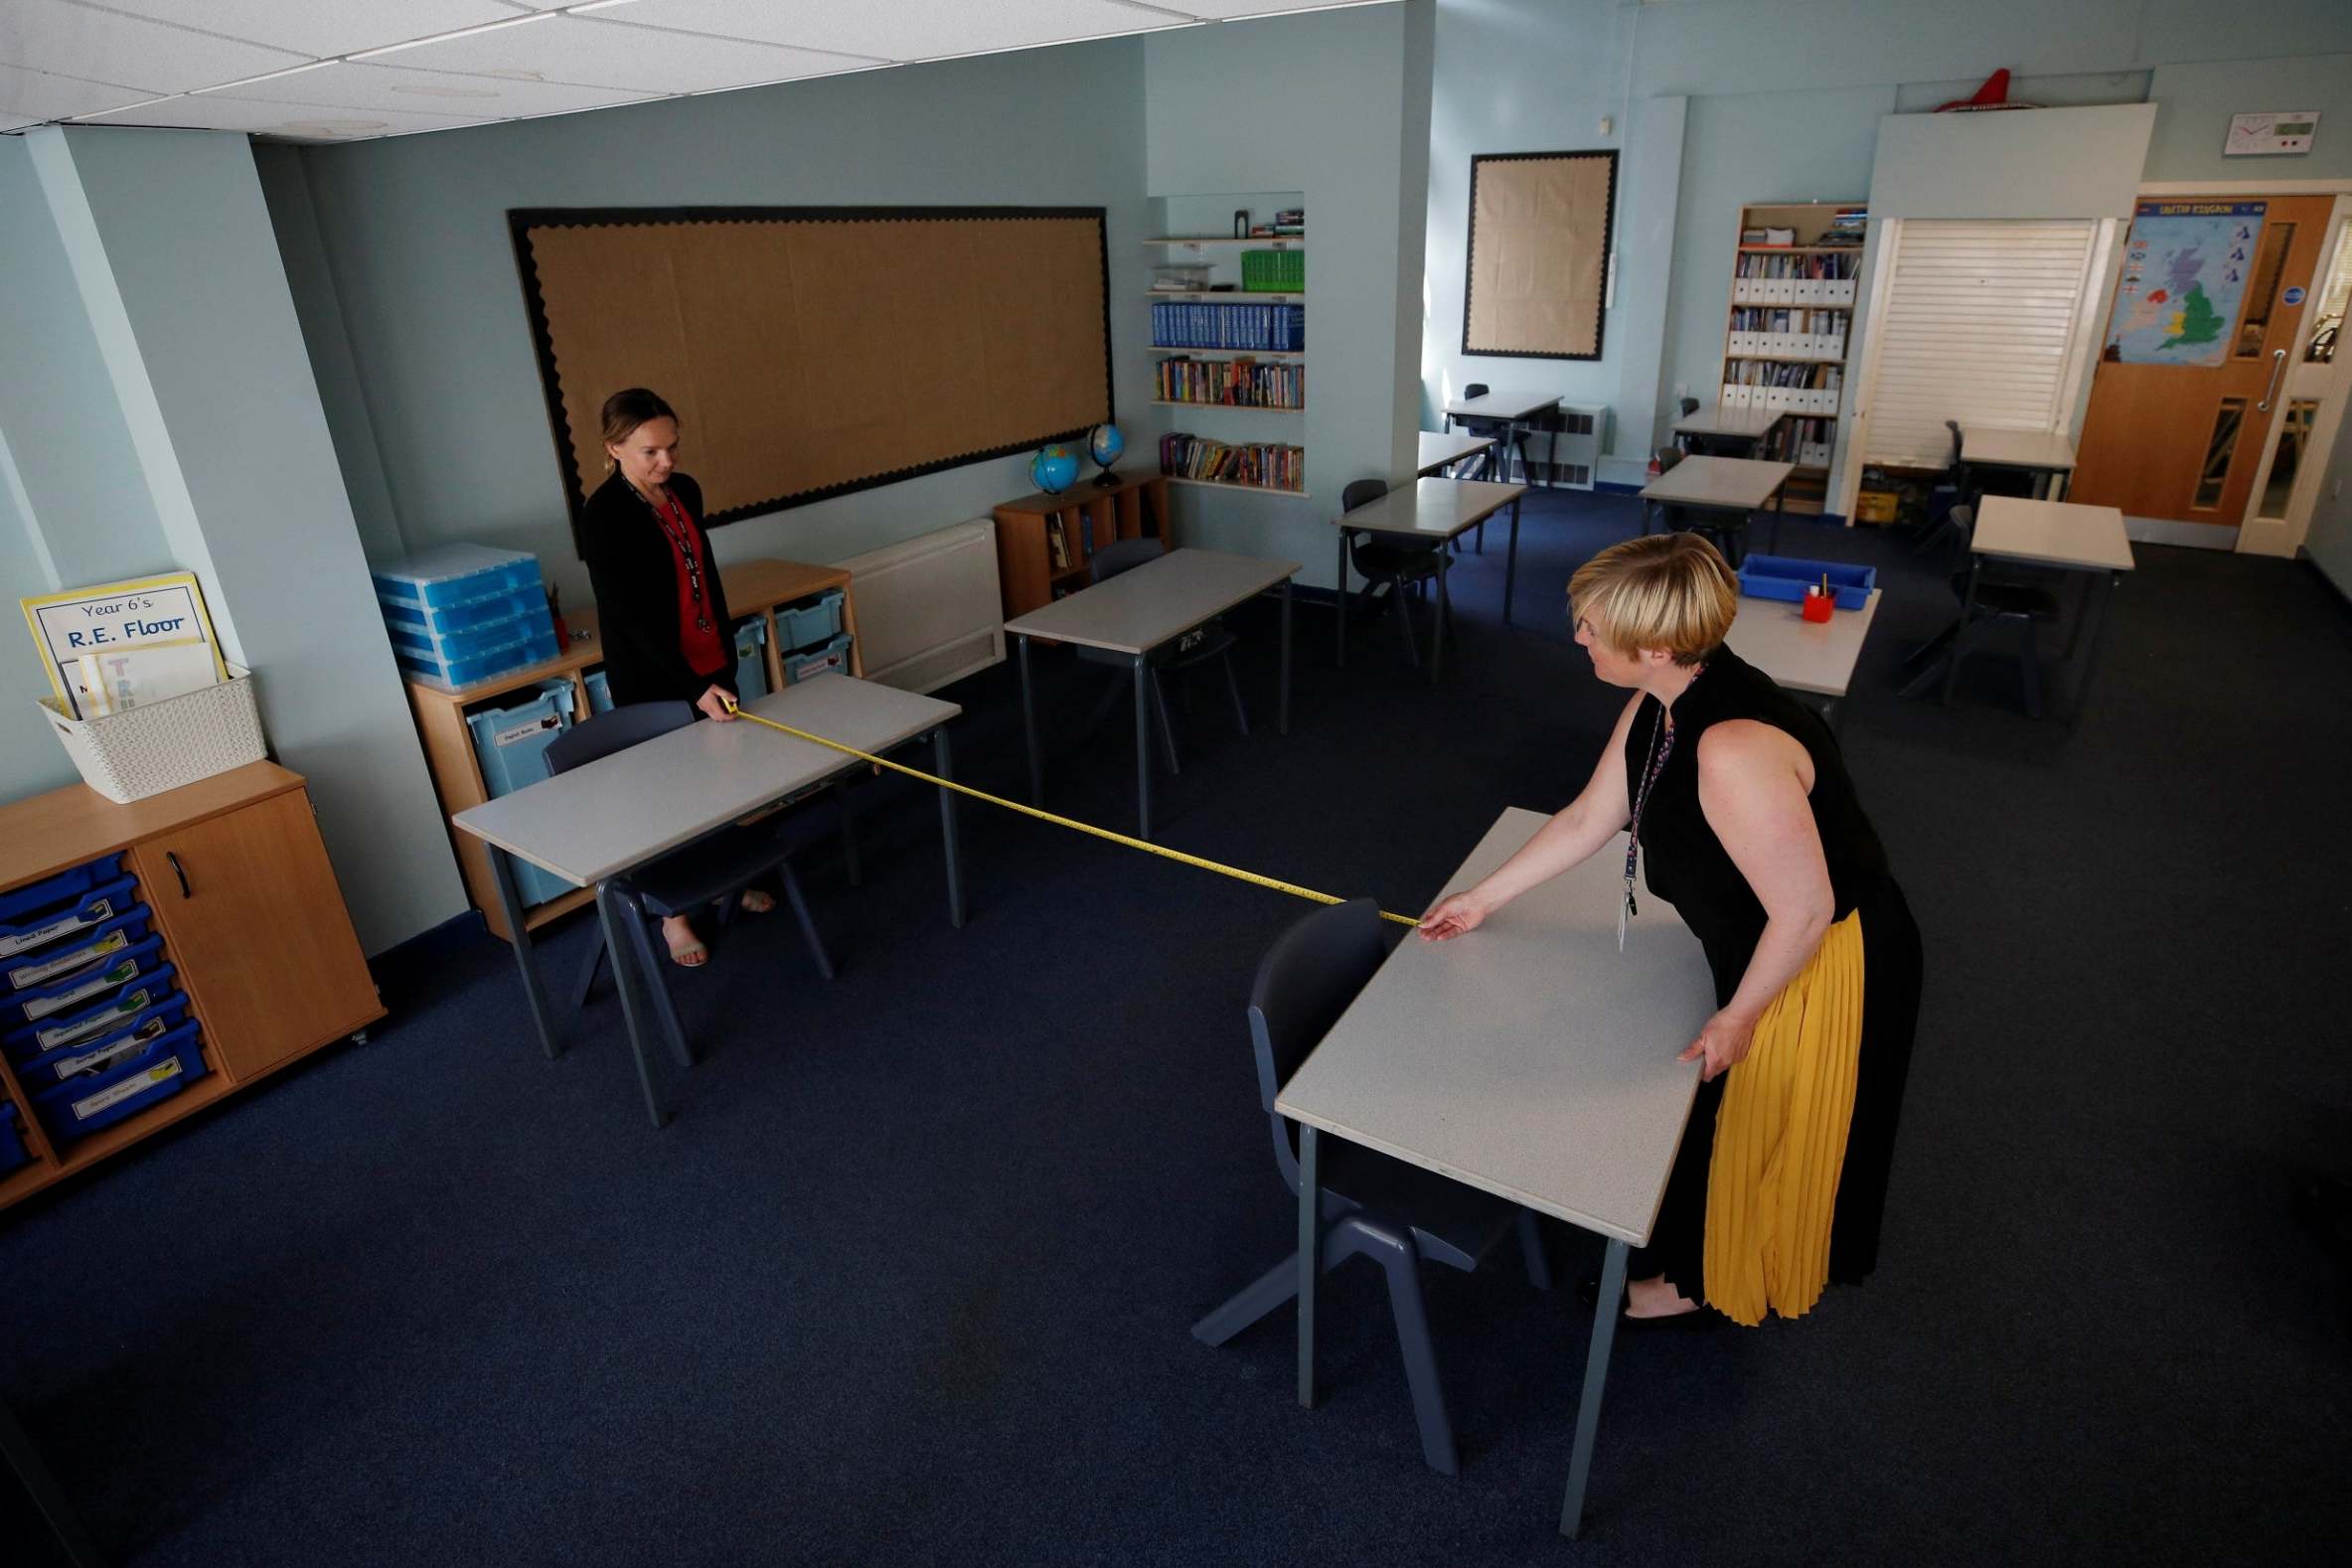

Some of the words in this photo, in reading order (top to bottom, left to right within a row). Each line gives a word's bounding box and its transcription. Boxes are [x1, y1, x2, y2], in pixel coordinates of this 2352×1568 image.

[81, 603, 122, 617] Year
[128, 597, 153, 610] 6's
[69, 627, 116, 648] R.E.
[124, 617, 185, 638] Floor
[15, 931, 37, 945] Lined
[38, 924, 59, 937] Paper
